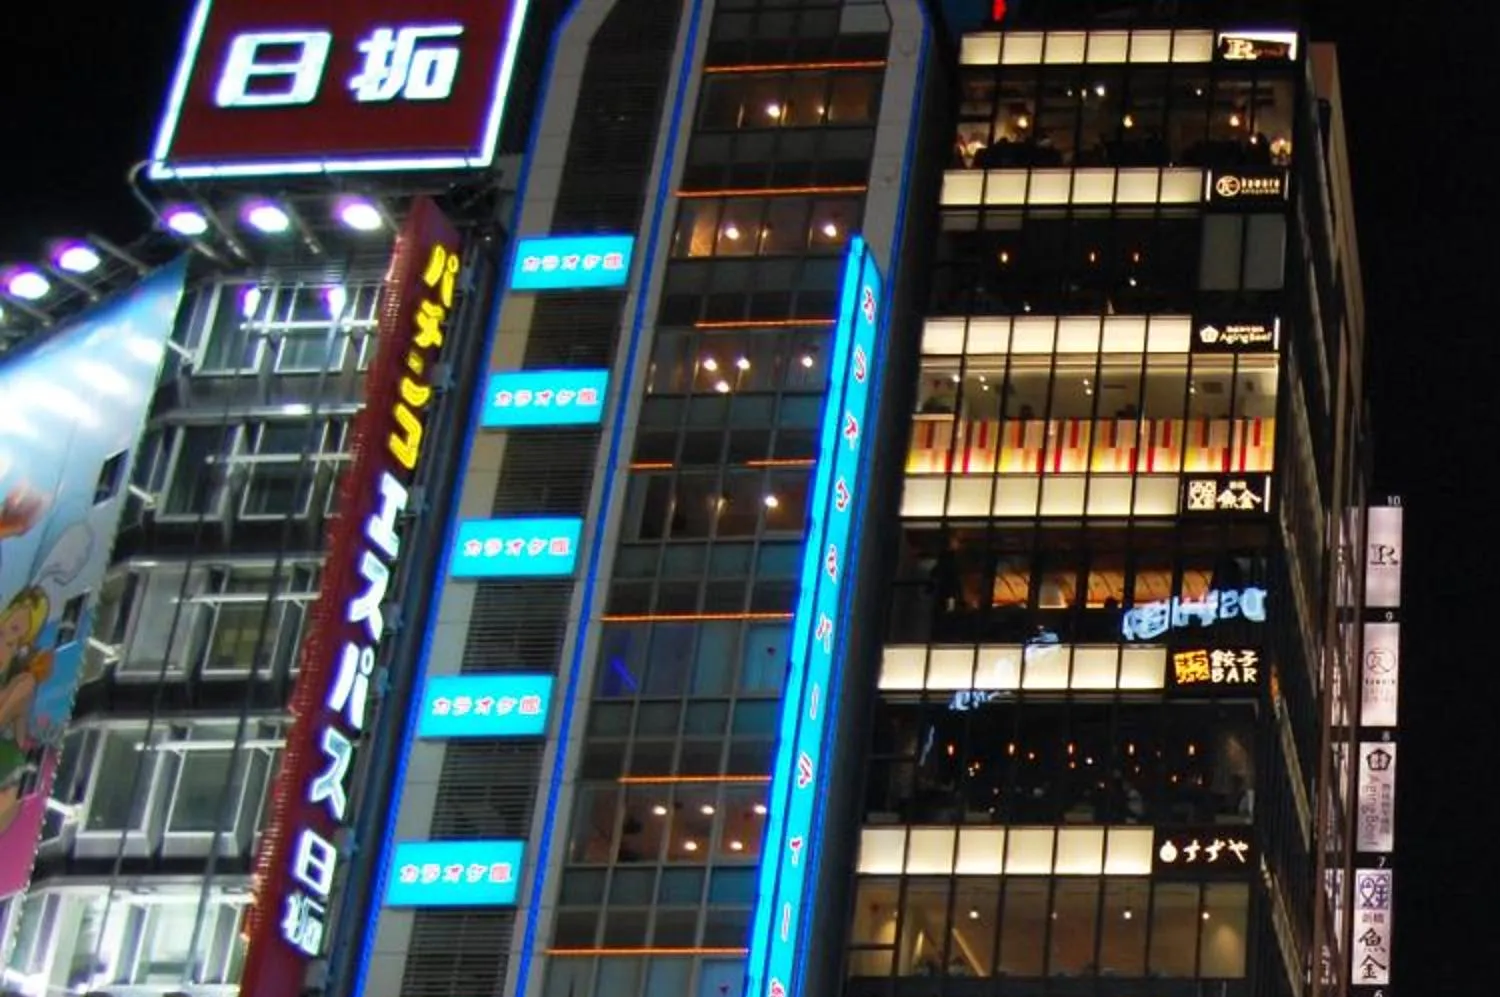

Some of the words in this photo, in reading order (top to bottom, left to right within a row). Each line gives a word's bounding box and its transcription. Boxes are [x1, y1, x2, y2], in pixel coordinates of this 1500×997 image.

[215, 25, 464, 107] 日拓
[1211, 668, 1258, 683] BAR
[1358, 928, 1388, 980] 魚金
